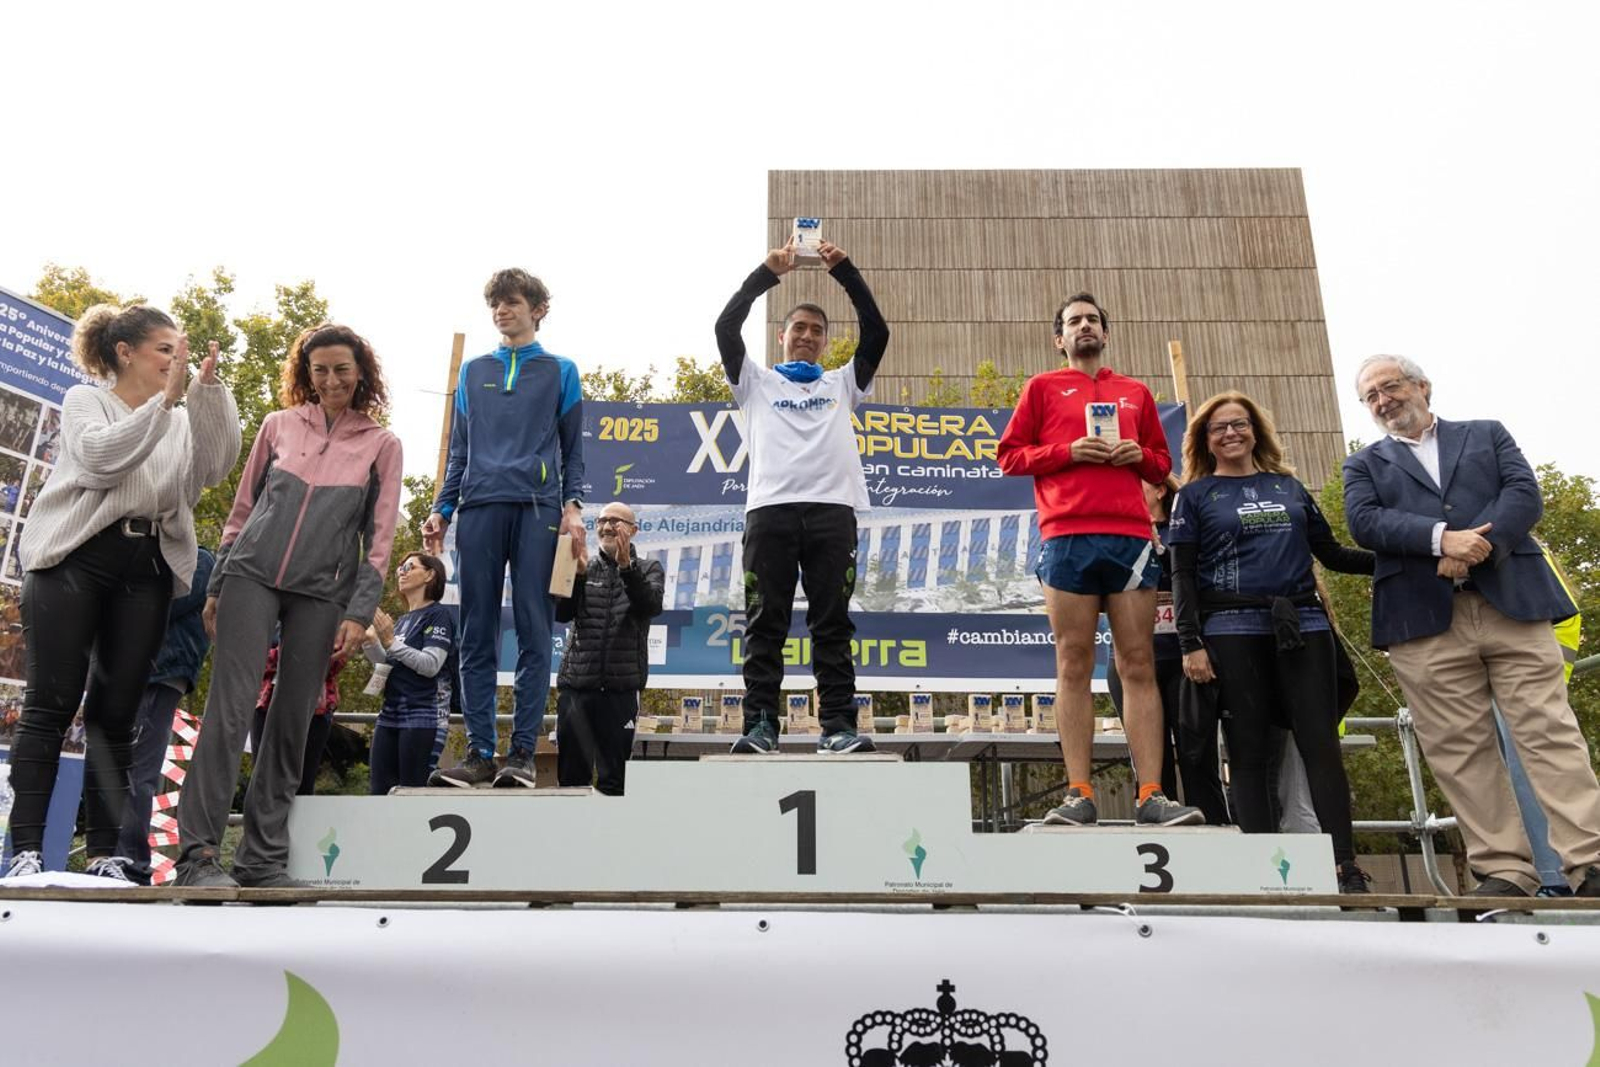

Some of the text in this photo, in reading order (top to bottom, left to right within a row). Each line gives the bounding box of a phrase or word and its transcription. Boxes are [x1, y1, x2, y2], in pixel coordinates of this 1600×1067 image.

[8, 326, 57, 352] Popular
[56, 347, 64, 358] y
[26, 320, 72, 346] Anivers
[15, 344, 37, 360] Paz
[38, 354, 46, 366] y
[47, 357, 59, 369] la
[0, 361, 49, 386] mpartiendo
[1091, 404, 1116, 417] XXV
[598, 416, 659, 442] 2025
[686, 410, 997, 473] XX ARRERA
[897, 463, 1004, 478] caminata
[864, 477, 954, 506] ntegración
[1237, 501, 1286, 514] 25
[657, 518, 744, 535] Alejandría
[433, 626, 446, 635] SC
[707, 613, 746, 647] 25
[779, 790, 816, 875] 1
[422, 814, 471, 884] 2
[1136, 843, 1174, 893] 3
[915, 881, 944, 889] Municipal
